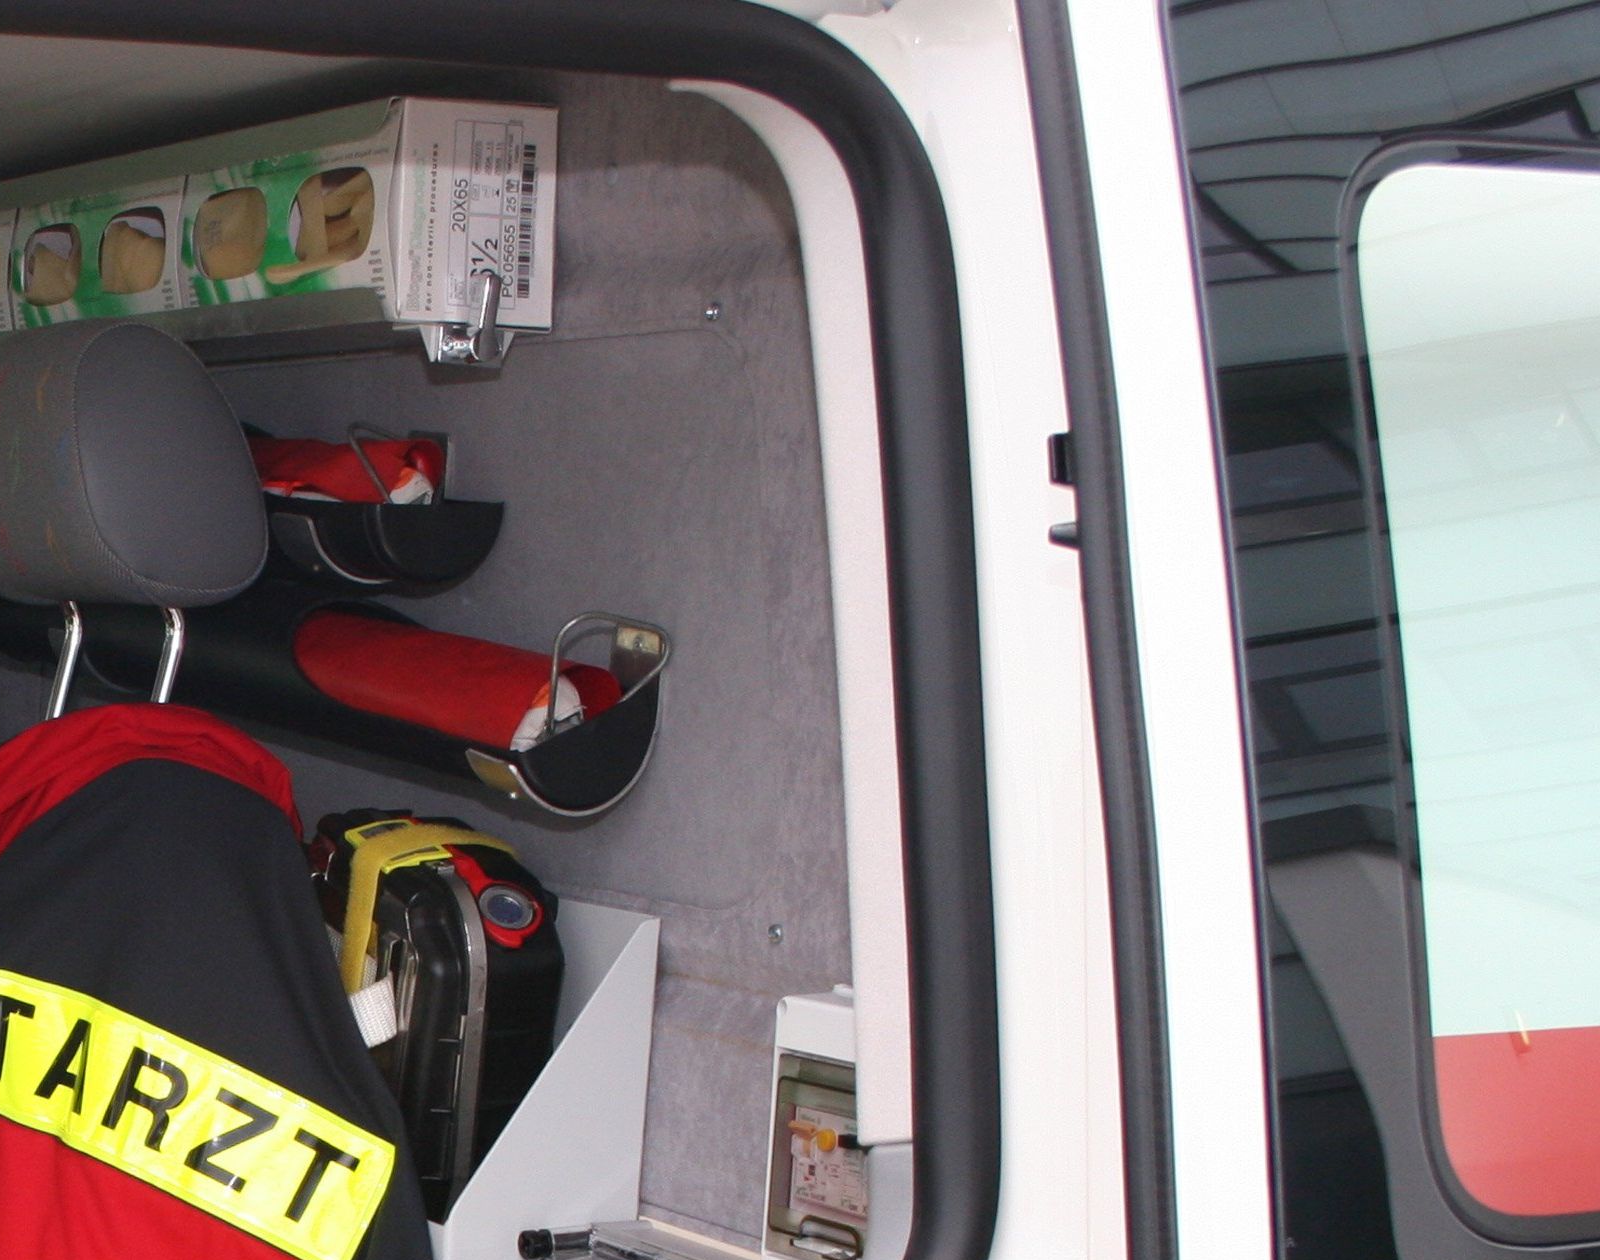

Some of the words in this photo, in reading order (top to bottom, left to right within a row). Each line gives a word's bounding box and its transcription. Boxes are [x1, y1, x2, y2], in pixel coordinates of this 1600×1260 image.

[425, 293, 433, 311] For
[429, 143, 438, 212] procedures
[452, 178, 468, 232] 20X65
[506, 196, 517, 213] 25
